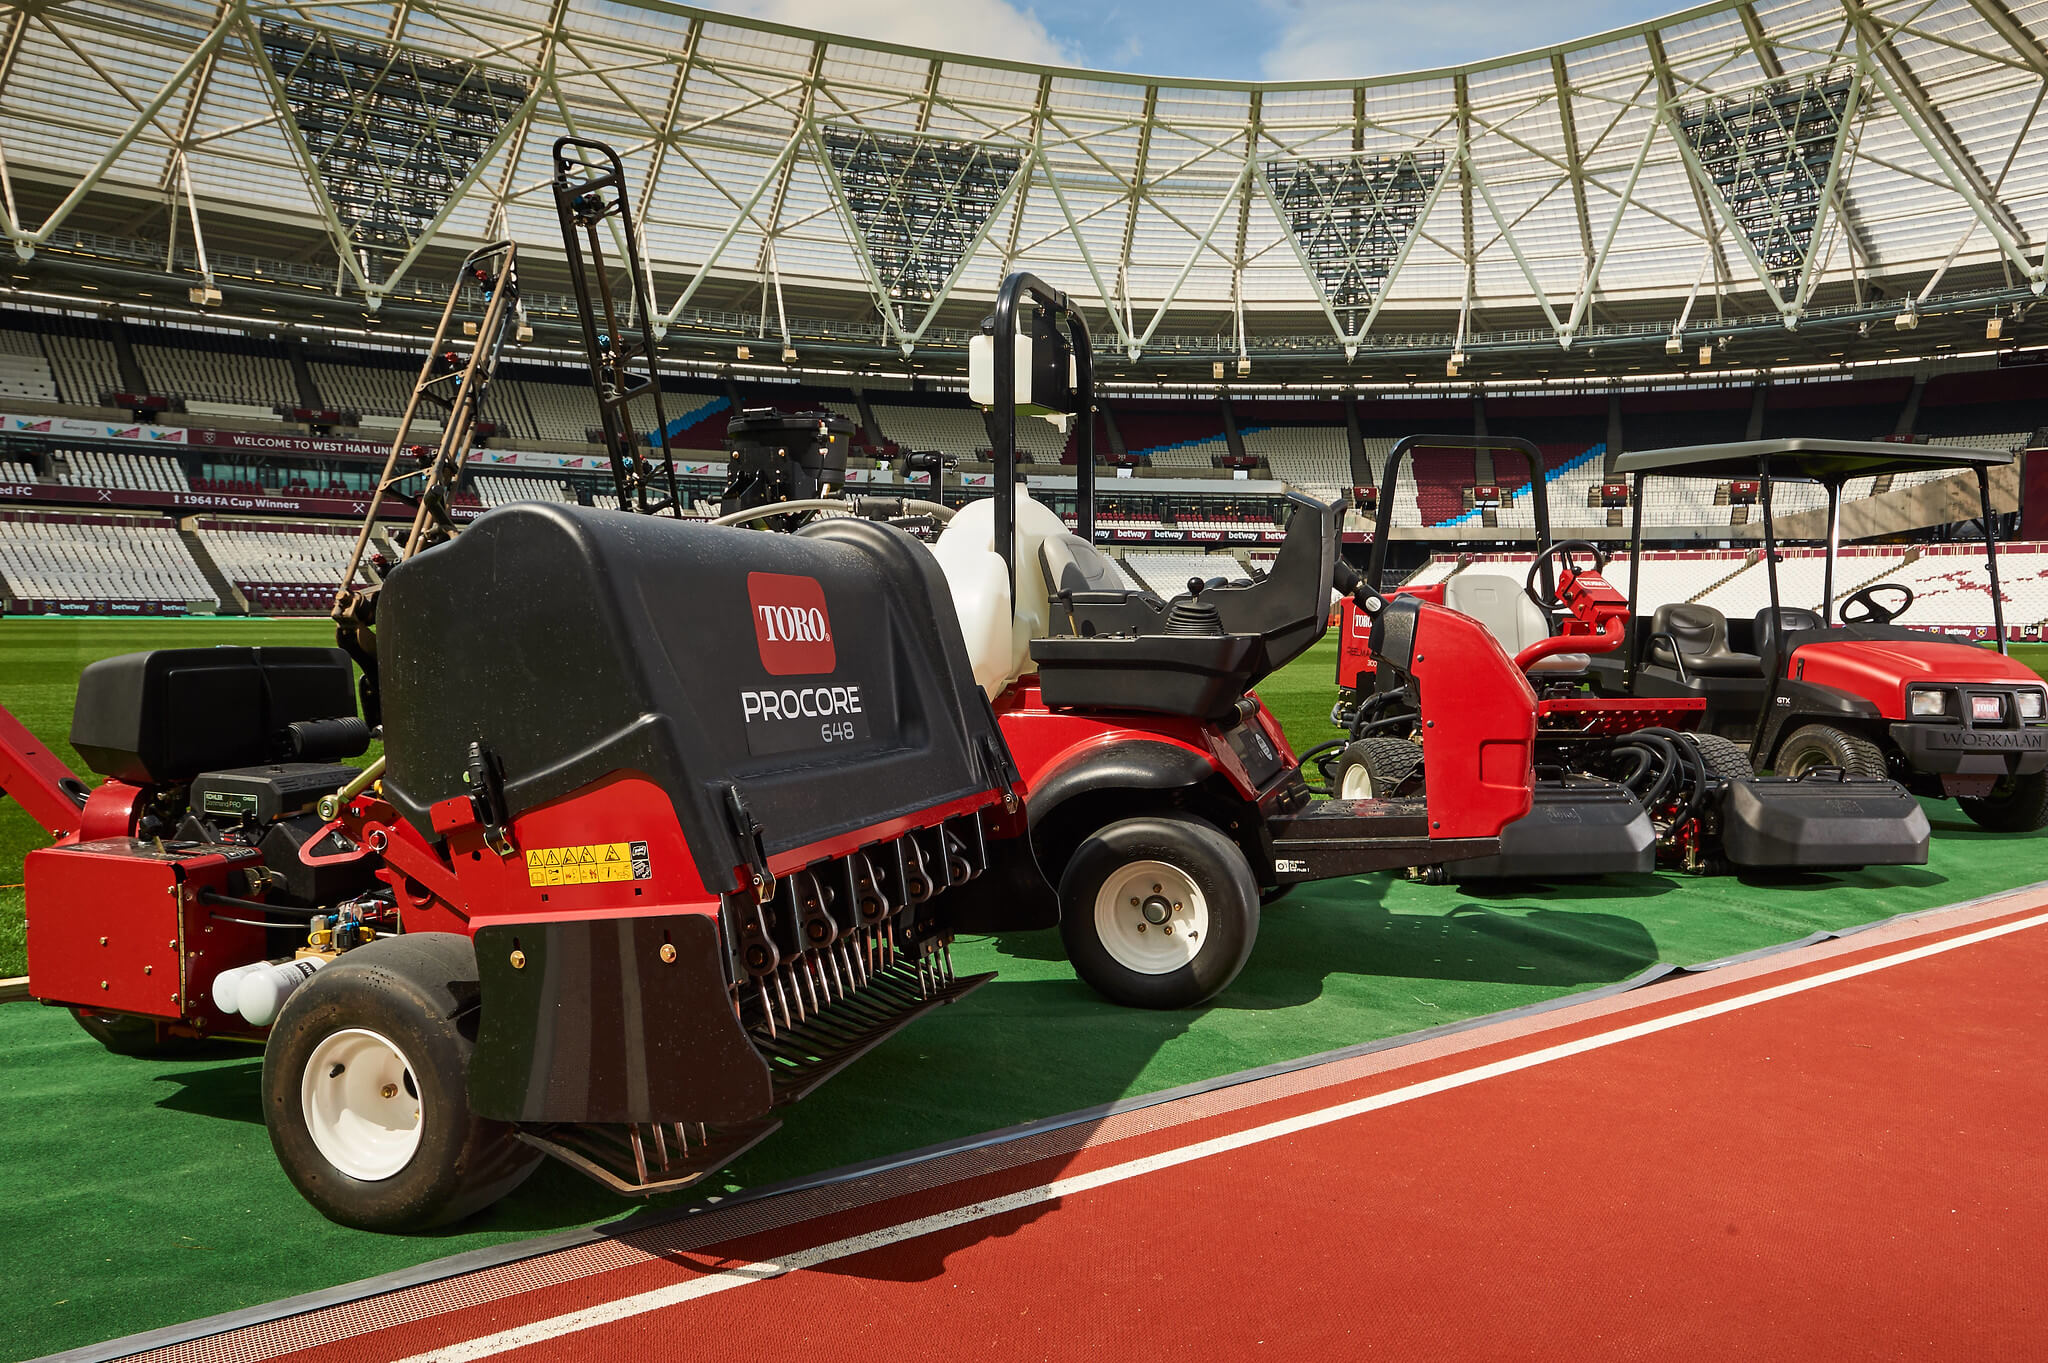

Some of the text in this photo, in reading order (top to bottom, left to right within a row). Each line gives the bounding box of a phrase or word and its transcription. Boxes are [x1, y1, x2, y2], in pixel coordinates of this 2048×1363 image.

[233, 436, 413, 456] WELCOME TO WEST HAM UNIED
[0, 486, 33, 496] ed FC
[184, 495, 300, 509] 1964 FA Cup Winners
[1095, 530, 1110, 540] way
[1117, 530, 1147, 540] betway
[1154, 530, 1184, 540] betway
[1191, 531, 1221, 541] betway
[1228, 532, 1258, 541] betway
[1265, 532, 1287, 540] betw
[60, 603, 89, 611] betway
[112, 603, 140, 611] betway
[758, 605, 826, 642] TORO
[741, 686, 862, 723] PROCORE
[1975, 703, 1997, 713] TORO
[821, 721, 855, 743] 648
[1943, 732, 2042, 748] WORKMAN
